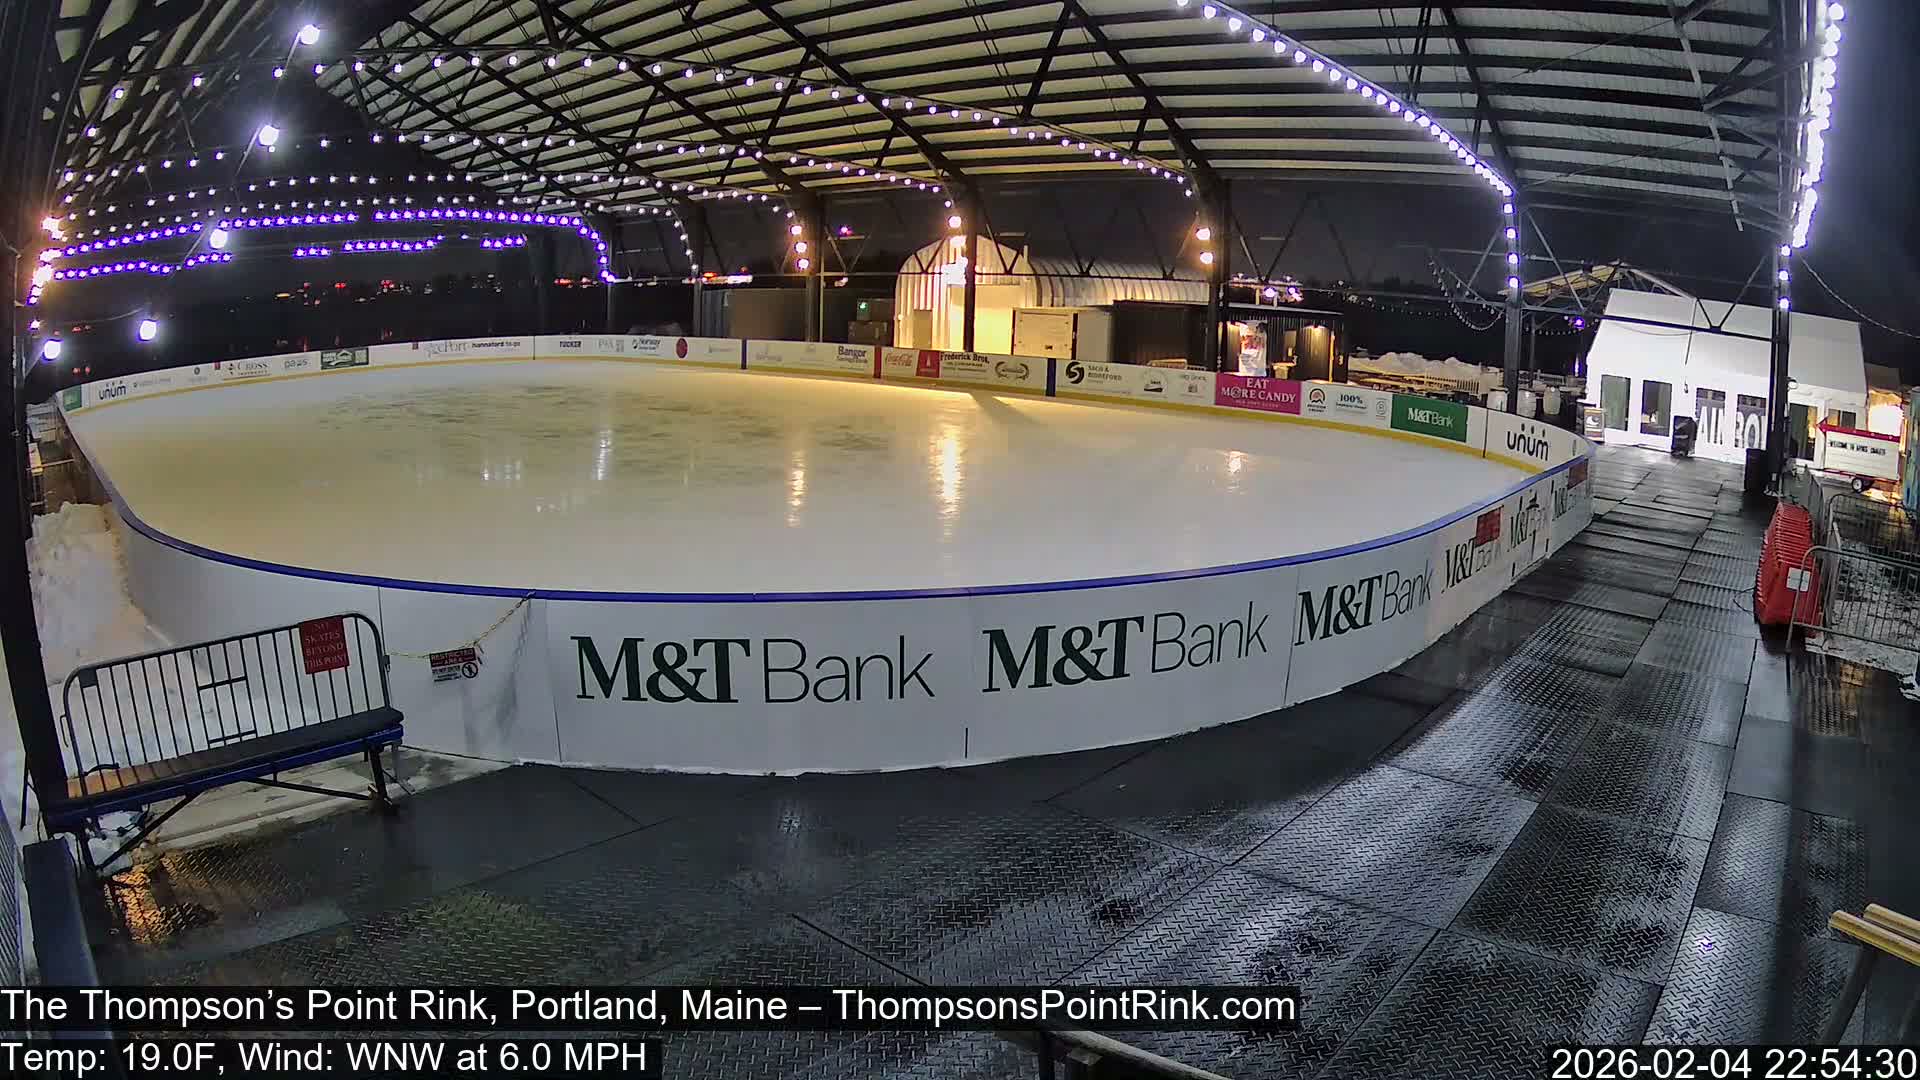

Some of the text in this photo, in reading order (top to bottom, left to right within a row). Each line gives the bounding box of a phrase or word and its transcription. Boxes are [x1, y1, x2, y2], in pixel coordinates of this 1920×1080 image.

[472, 341, 504, 349] hannaford
[838, 345, 867, 359] Bangor
[940, 351, 990, 364] Frederick Bros.
[1246, 377, 1269, 390] EAT
[99, 384, 127, 400] unum
[1221, 386, 1296, 403] MORE CANDY
[1340, 393, 1363, 405] 100%
[1407, 407, 1454, 428] M&T Bank
[1507, 427, 1549, 461] unum
[1441, 537, 1476, 594] M&T
[1294, 559, 1434, 646] M&T Bank
[305, 631, 341, 643] SKATES
[305, 643, 344, 656] BEYOND
[981, 601, 1271, 692] M&T Bank
[305, 655, 346, 668] THIS POINT
[431, 649, 474, 661] RESTRICTED
[570, 635, 936, 703] M&T Bank
